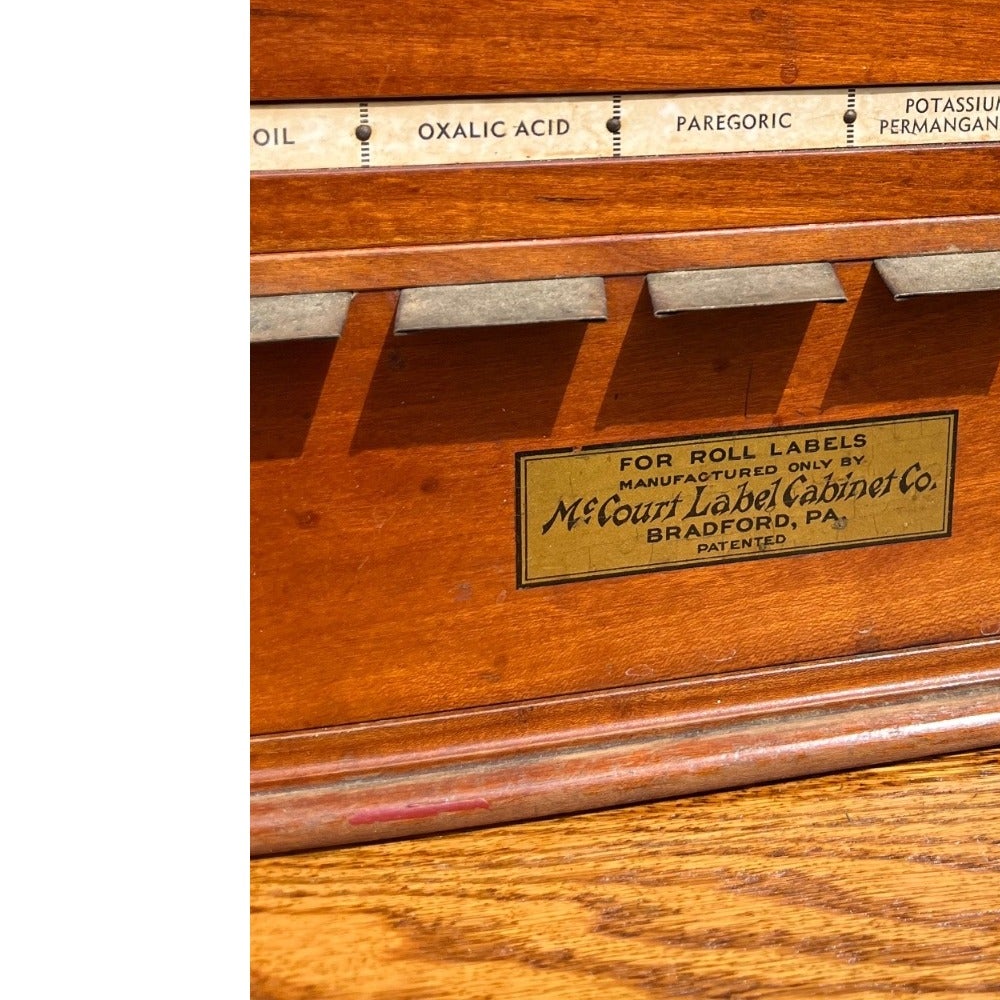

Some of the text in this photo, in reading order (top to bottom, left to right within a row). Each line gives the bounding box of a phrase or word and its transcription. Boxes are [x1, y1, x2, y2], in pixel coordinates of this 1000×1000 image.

[418, 118, 571, 140] OXALIC ACID
[676, 112, 793, 132] PAREGORIC
[253, 127, 296, 146] OIL
[620, 434, 867, 471] FOR ROLL LABELS
[619, 455, 865, 491] MANUFACTURED ONLY BY
[541, 461, 937, 535] McCourt Label Cabinet Co.
[646, 508, 847, 543] BRADFORD, PA.
[697, 534, 787, 554] PATENTED
